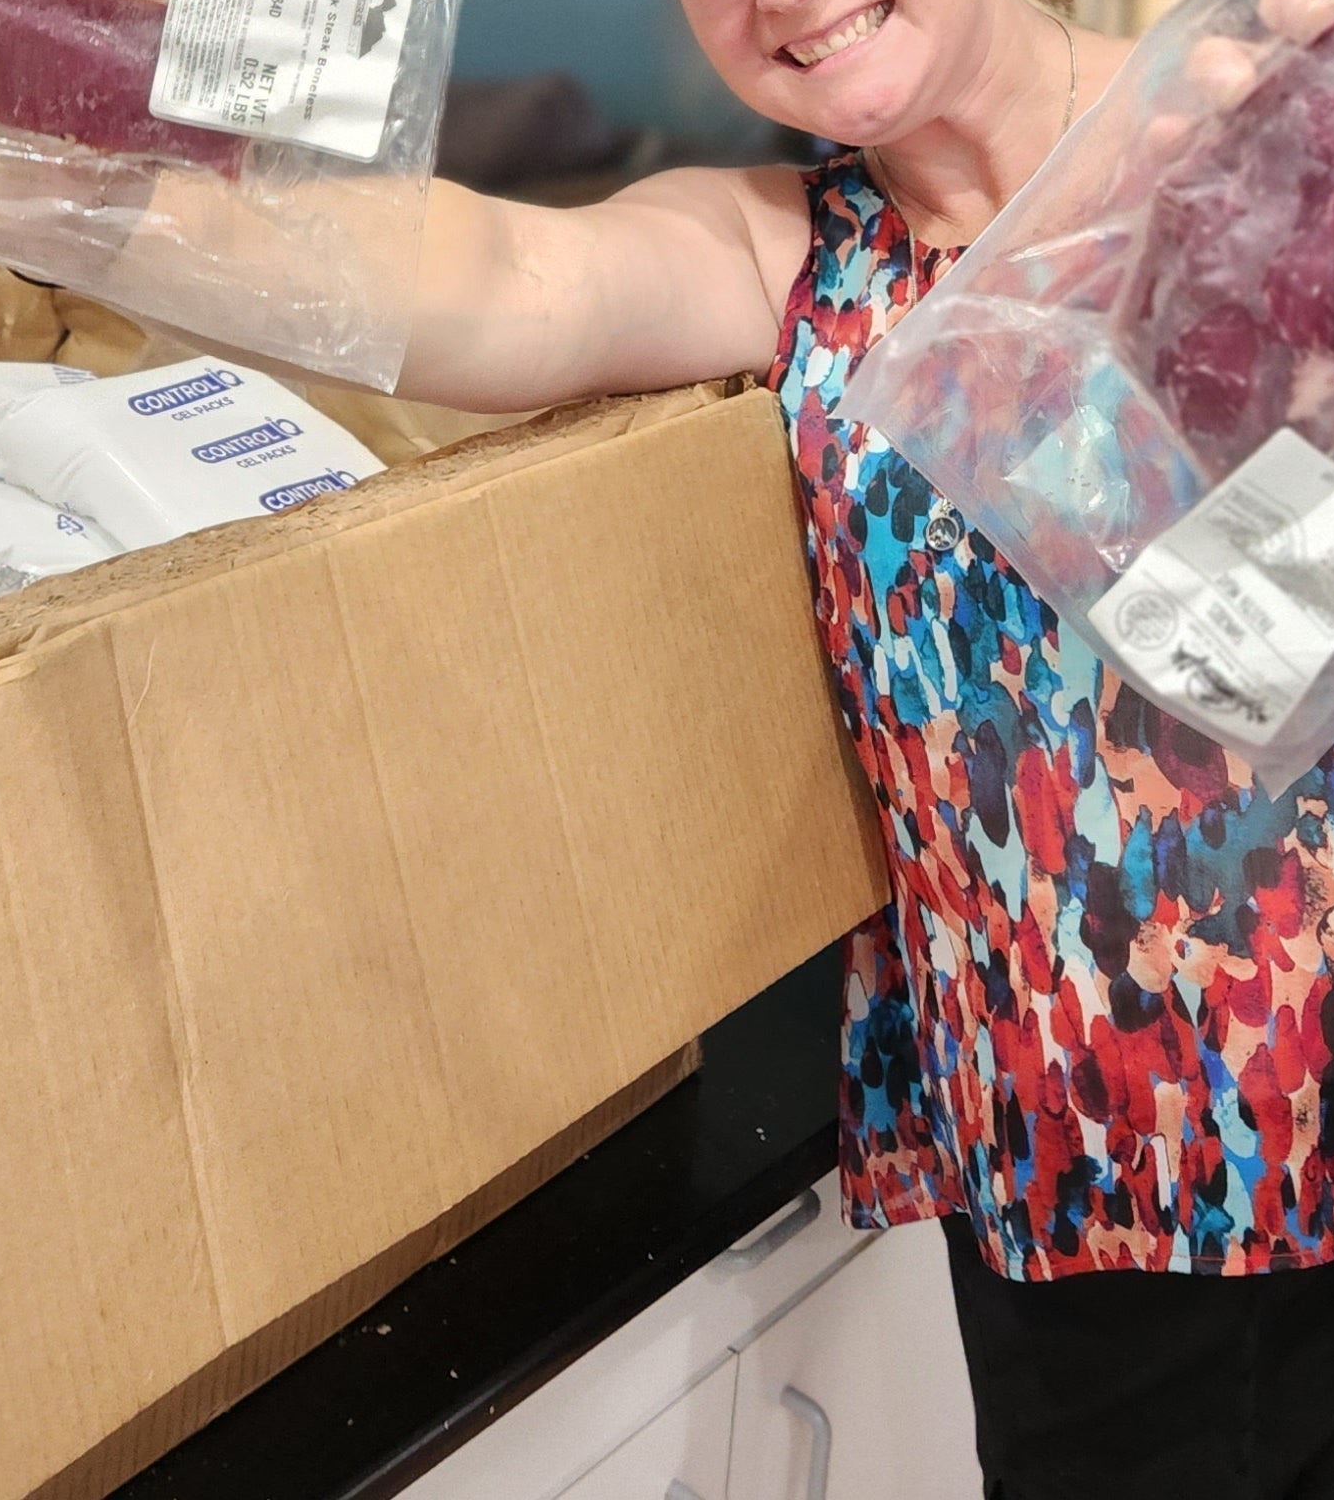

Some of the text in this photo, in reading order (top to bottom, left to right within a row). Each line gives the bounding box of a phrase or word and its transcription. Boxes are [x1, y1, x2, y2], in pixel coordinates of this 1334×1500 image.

[320, 11, 337, 53] Steak
[240, 56, 259, 90] 0.52
[303, 55, 327, 121] Boneless
[232, 93, 250, 123] LBS
[249, 62, 277, 127] NET WT.
[133, 378, 221, 414] CONTROL
[171, 396, 235, 421] GEL PACKS
[197, 428, 281, 461] CONTROL
[236, 444, 297, 469] GEL PACKS
[264, 478, 344, 510] CONTROL
